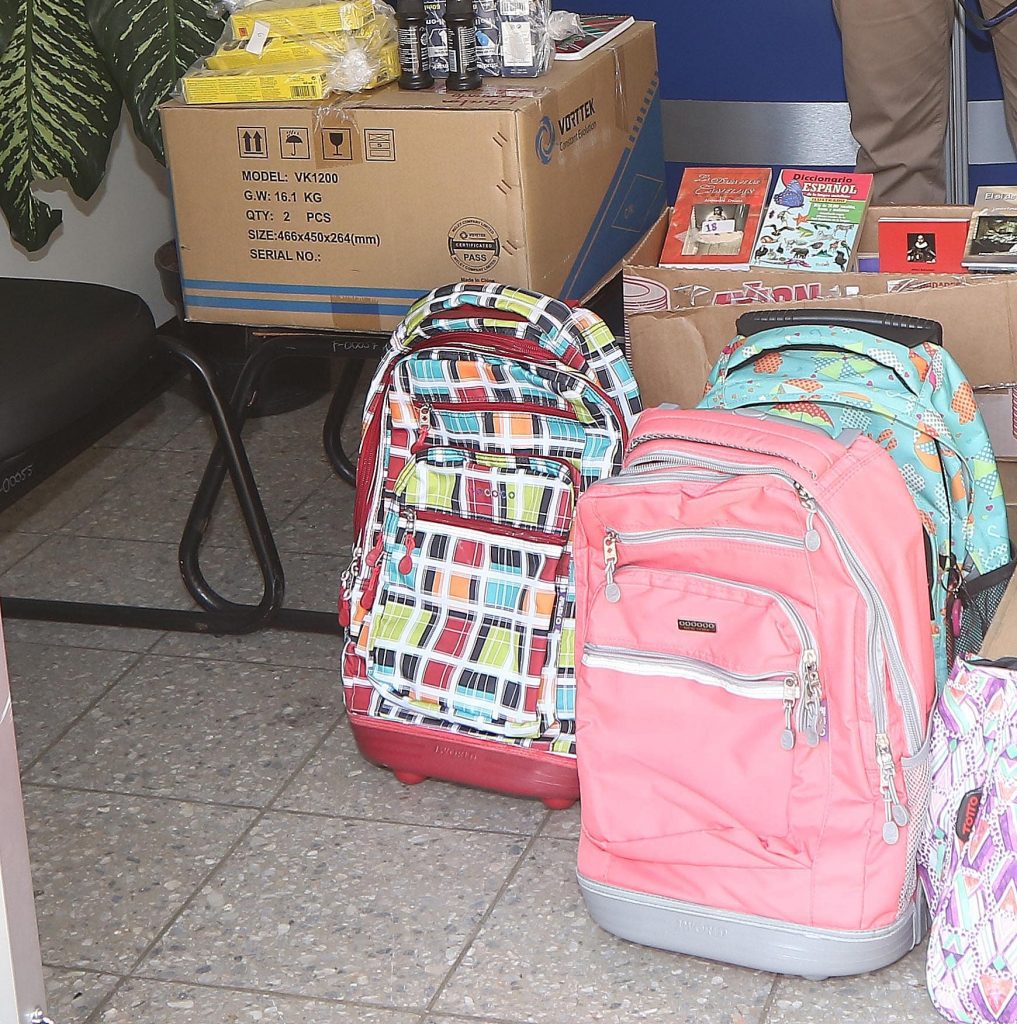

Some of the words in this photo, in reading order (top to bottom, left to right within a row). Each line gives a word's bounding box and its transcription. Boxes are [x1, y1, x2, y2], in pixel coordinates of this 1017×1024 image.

[558, 98, 596, 136] VORTTEK
[242, 170, 288, 183] MODEL:
[294, 172, 338, 184] VK1200
[793, 173, 853, 183] Diccionario
[802, 182, 858, 195] ESPAÑOL
[244, 190, 271, 202] G.W:
[275, 192, 298, 202] 16.1
[304, 192, 322, 203] KG
[985, 192, 994, 201] El
[246, 210, 274, 222] QTY:
[283, 211, 291, 222] 2
[307, 212, 332, 223] PCS
[248, 229, 381, 247] SIZE:466x450x264(mm)
[250, 249, 293, 261] SERIAL
[296, 250, 321, 262] NO.:
[463, 253, 487, 262] PASS
[962, 796, 979, 835] TOTTO
